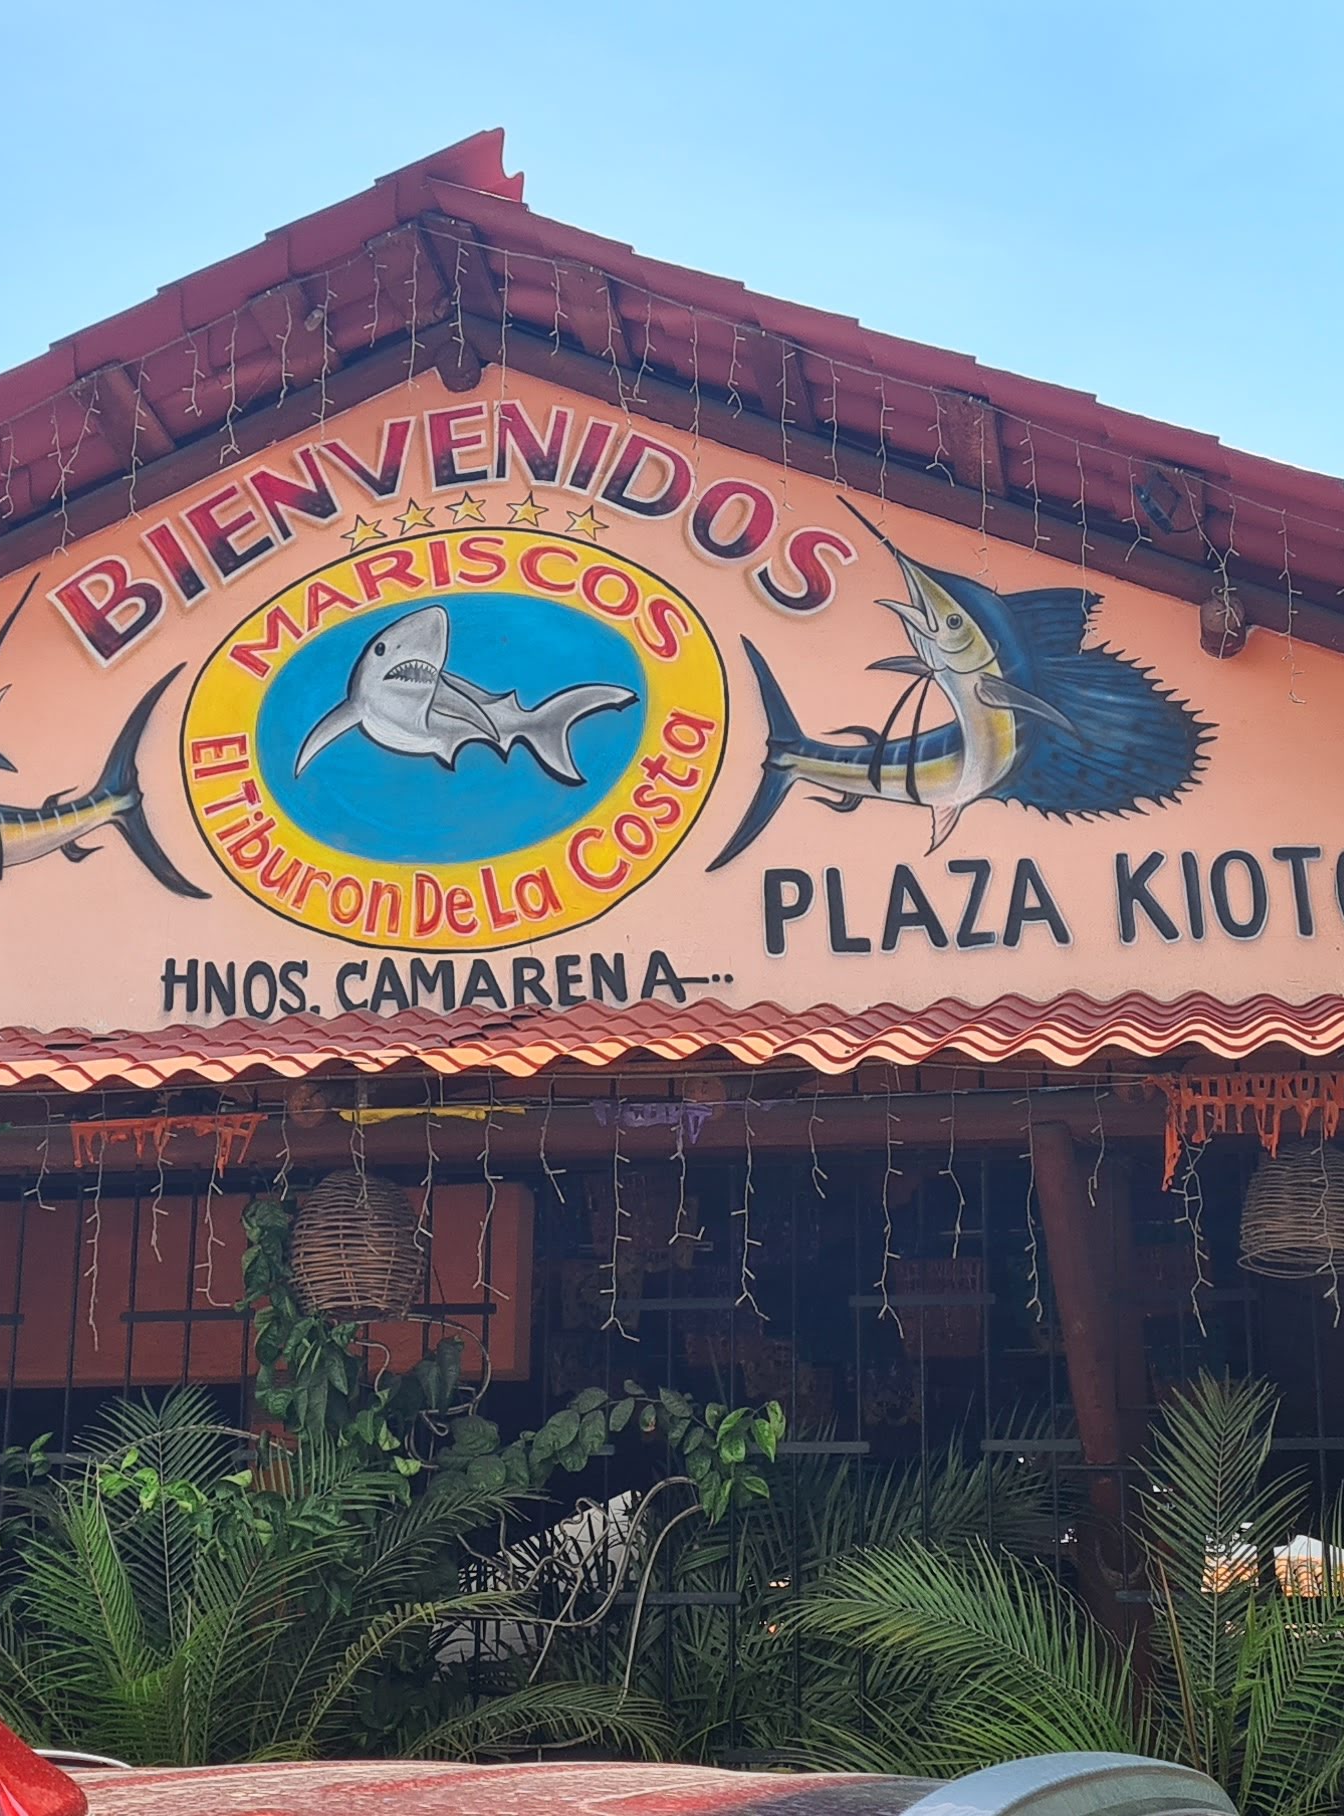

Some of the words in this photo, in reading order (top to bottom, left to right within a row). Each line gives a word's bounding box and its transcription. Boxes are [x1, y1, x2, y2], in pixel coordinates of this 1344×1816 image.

[47, 401, 858, 667] BIENVENIDOS
[228, 535, 693, 681] MARISCOS
[191, 733, 250, 781] El
[568, 710, 716, 891] Costa
[204, 778, 402, 936] Tiburon
[413, 871, 479, 938] De
[479, 865, 563, 932] La
[762, 857, 1072, 957] PLAZA
[161, 958, 321, 1019] HNOS.
